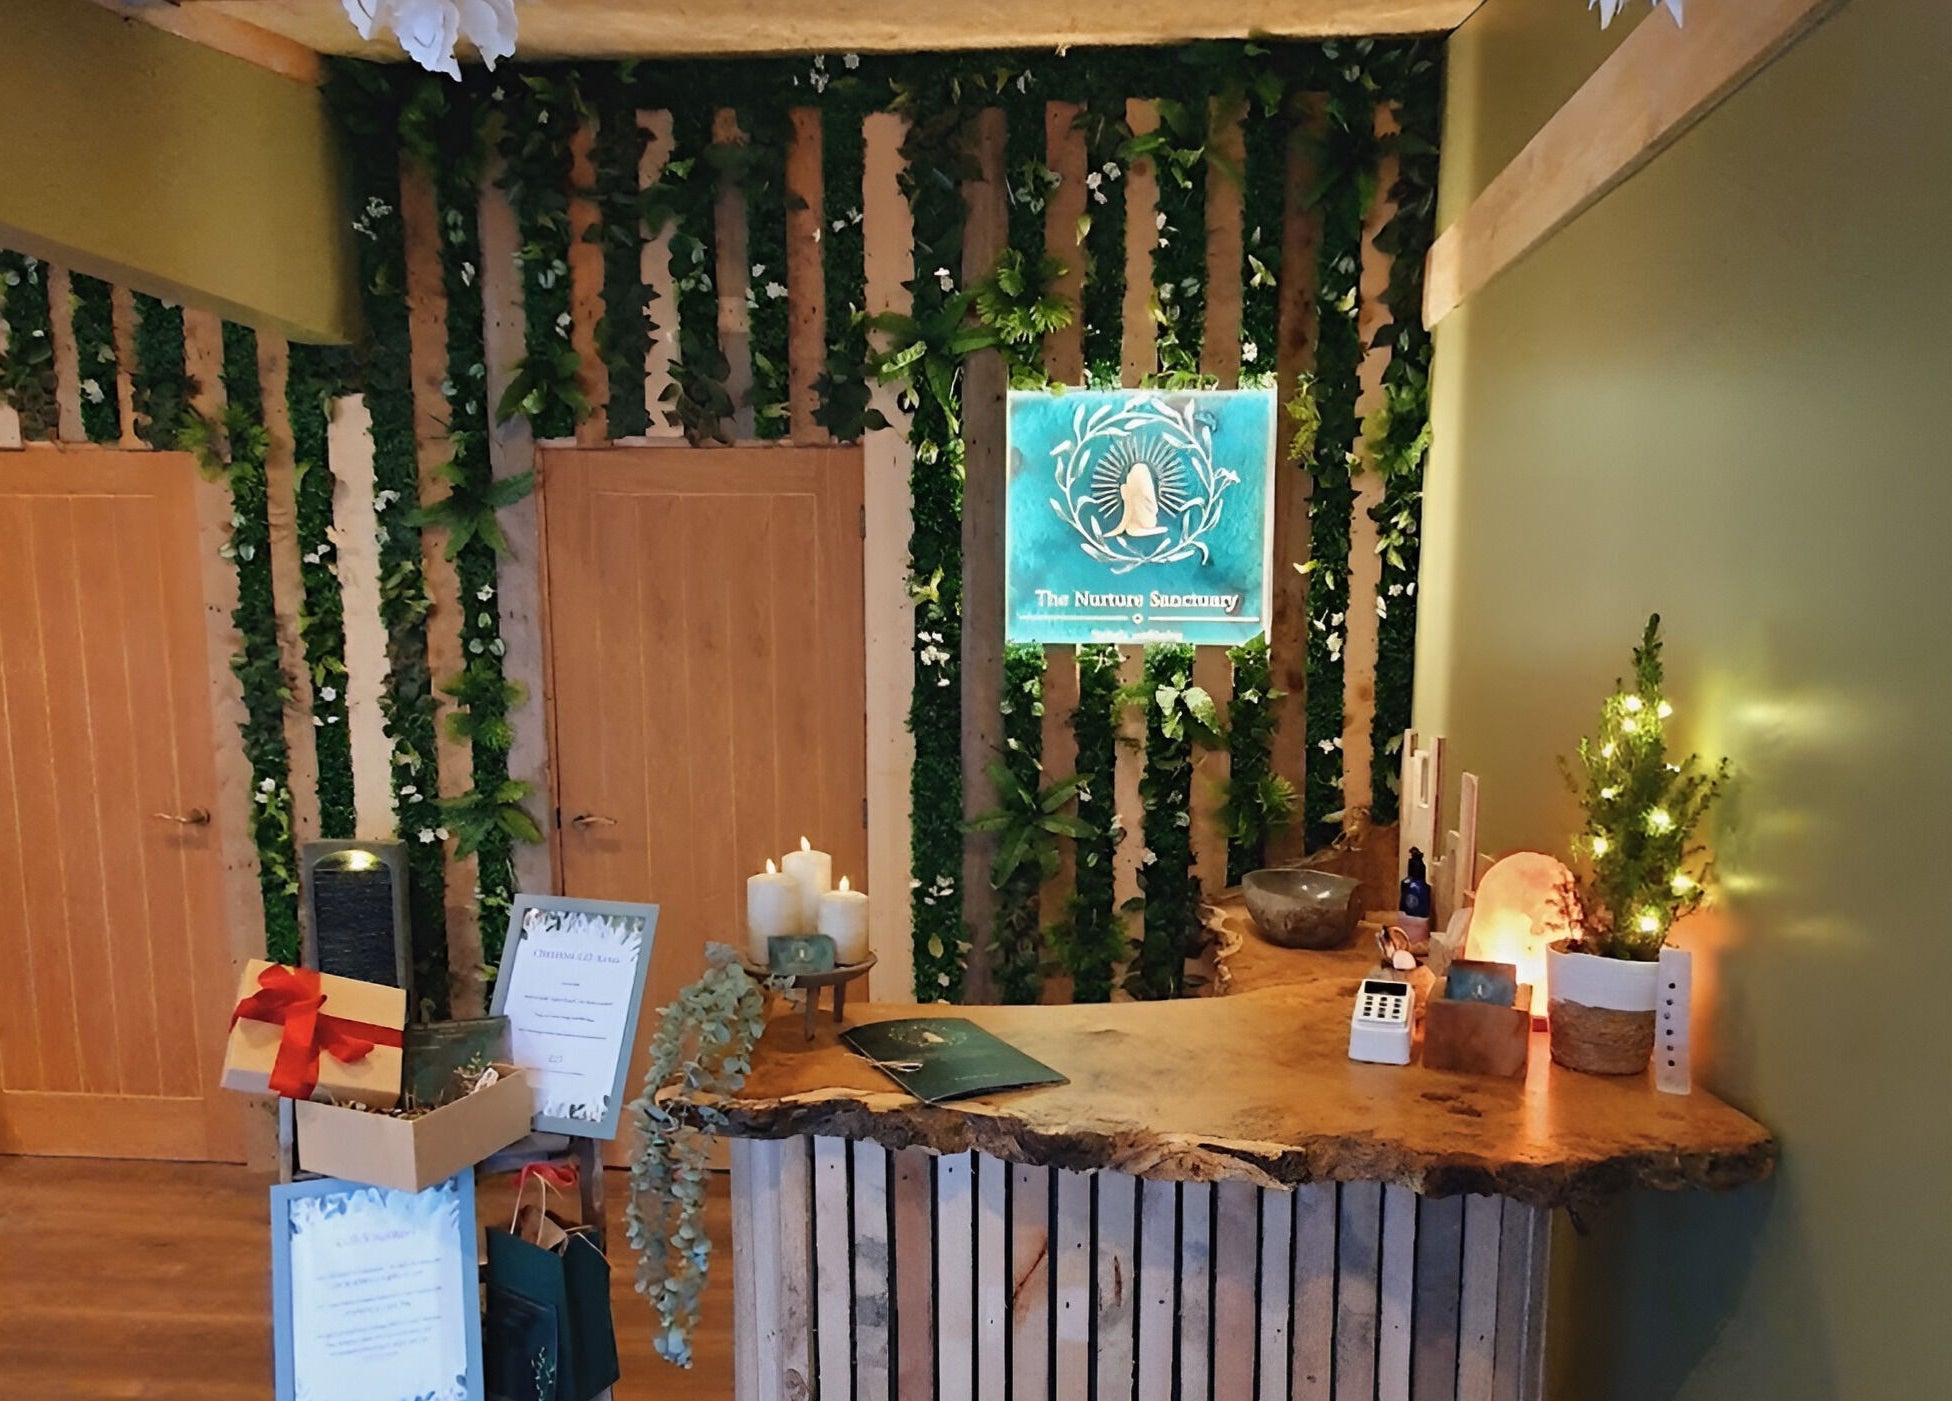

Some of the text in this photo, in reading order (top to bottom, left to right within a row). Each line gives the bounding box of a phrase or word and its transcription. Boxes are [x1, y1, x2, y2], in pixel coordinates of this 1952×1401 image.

[1035, 589, 1239, 613] The Nurture Sanctuary
